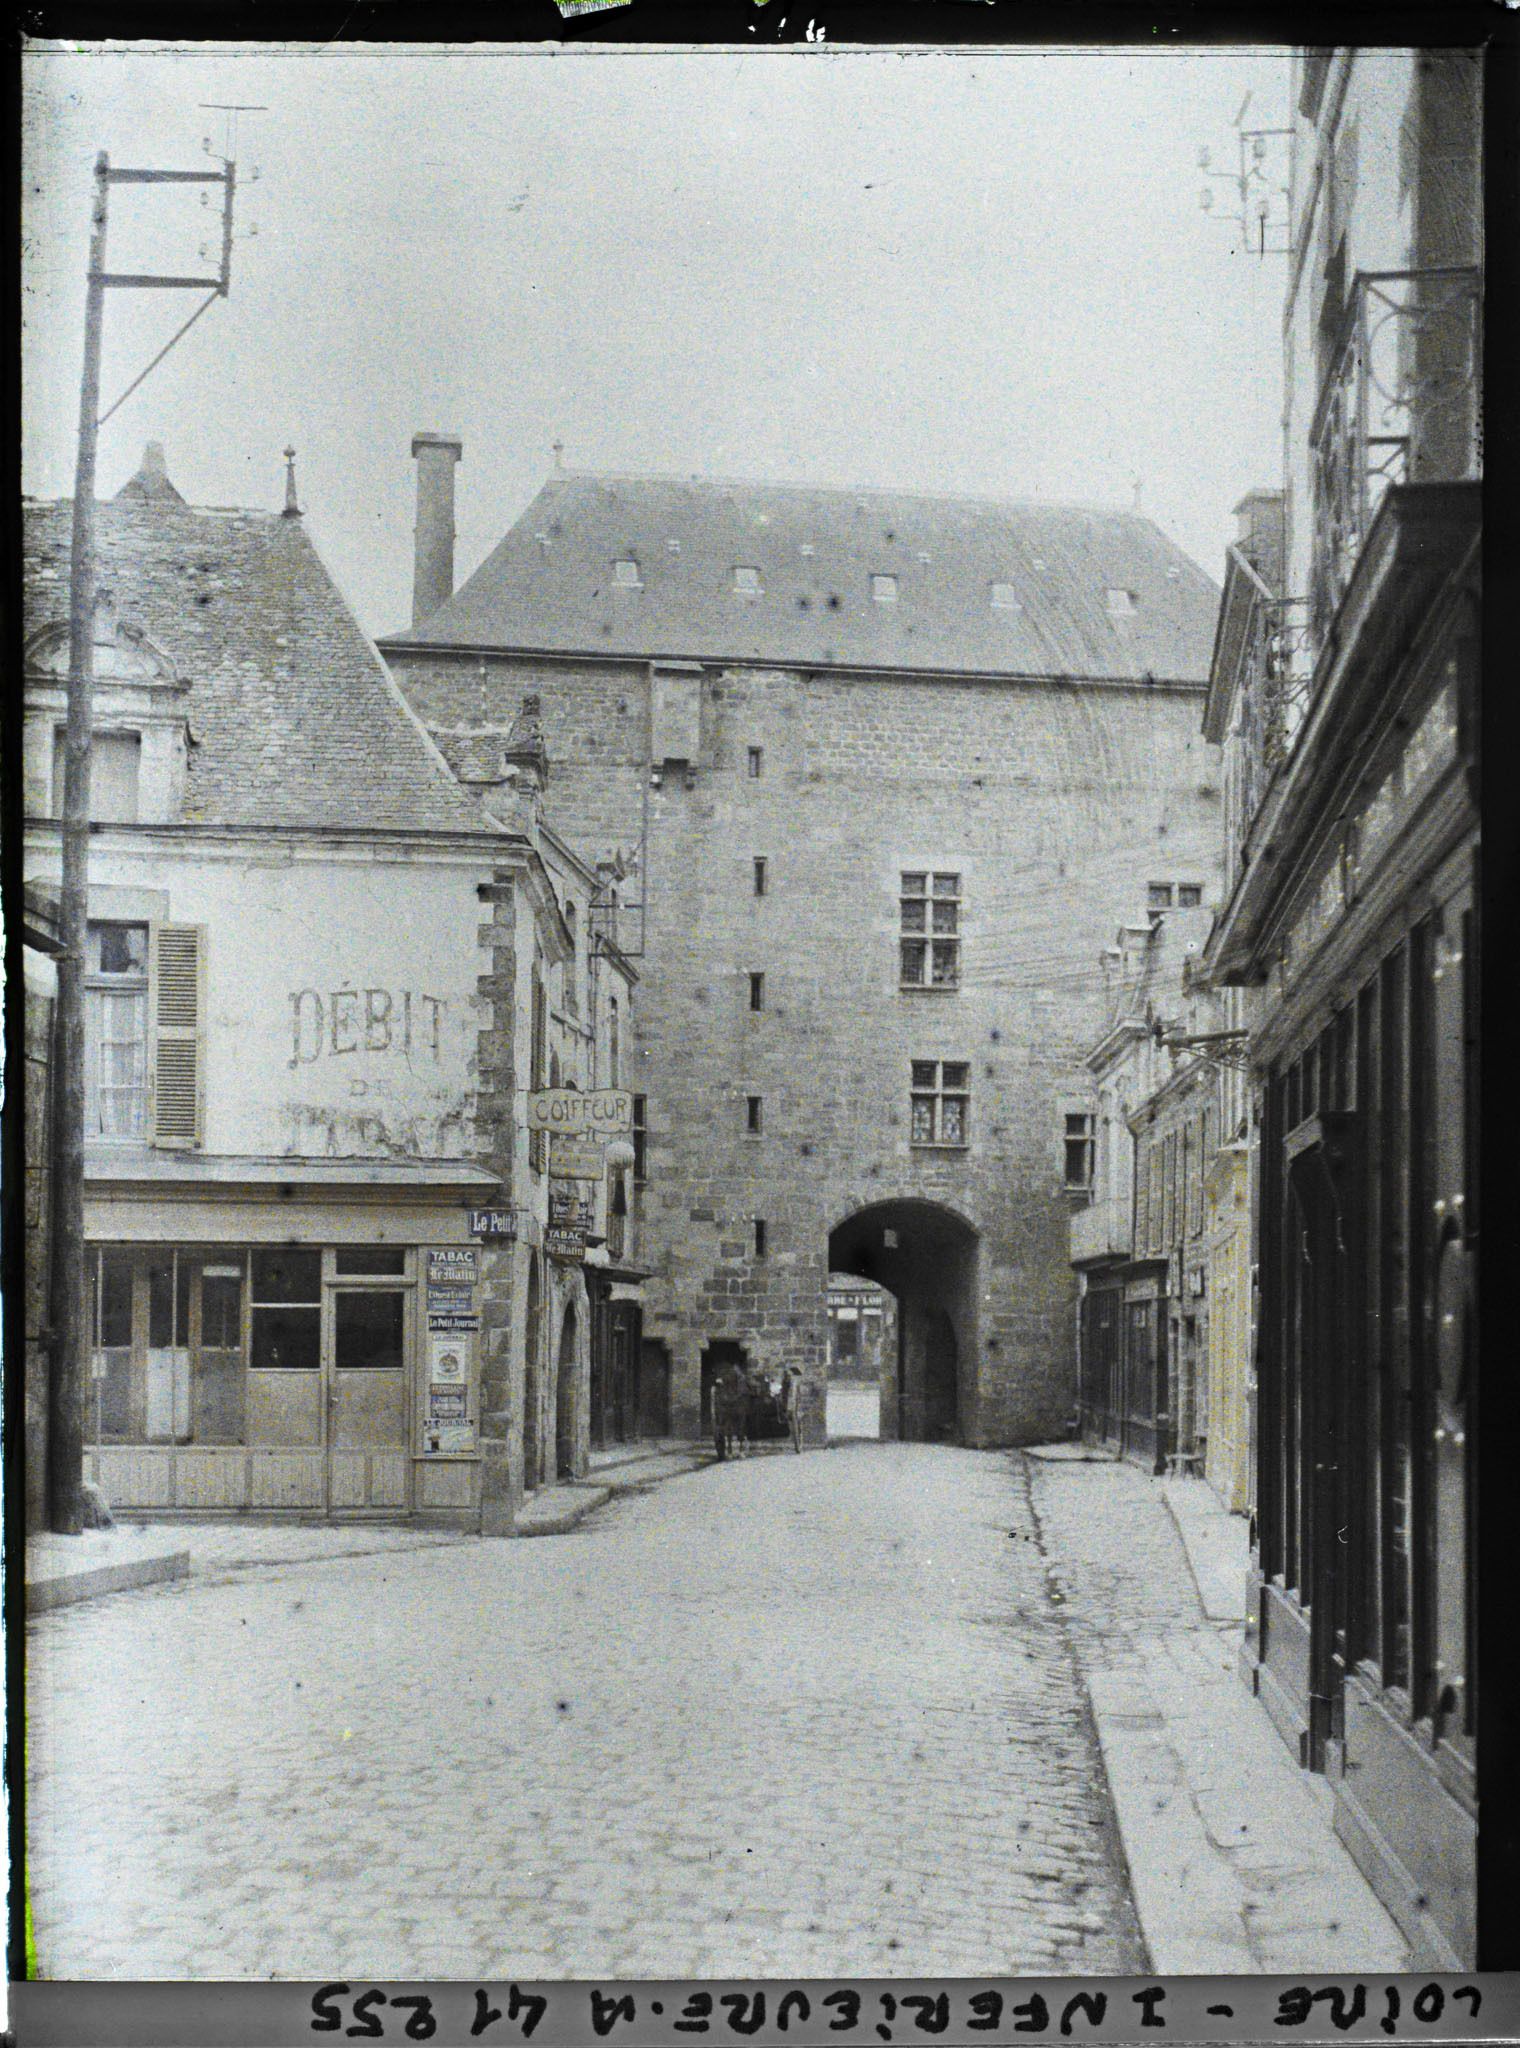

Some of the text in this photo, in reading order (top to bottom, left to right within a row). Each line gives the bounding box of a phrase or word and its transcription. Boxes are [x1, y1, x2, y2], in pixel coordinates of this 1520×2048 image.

[535, 1099, 626, 1122] COIFFEUR
[473, 1211, 487, 1231] Le
[548, 1230, 582, 1241] TABAC
[431, 1251, 474, 1262] TABAC
